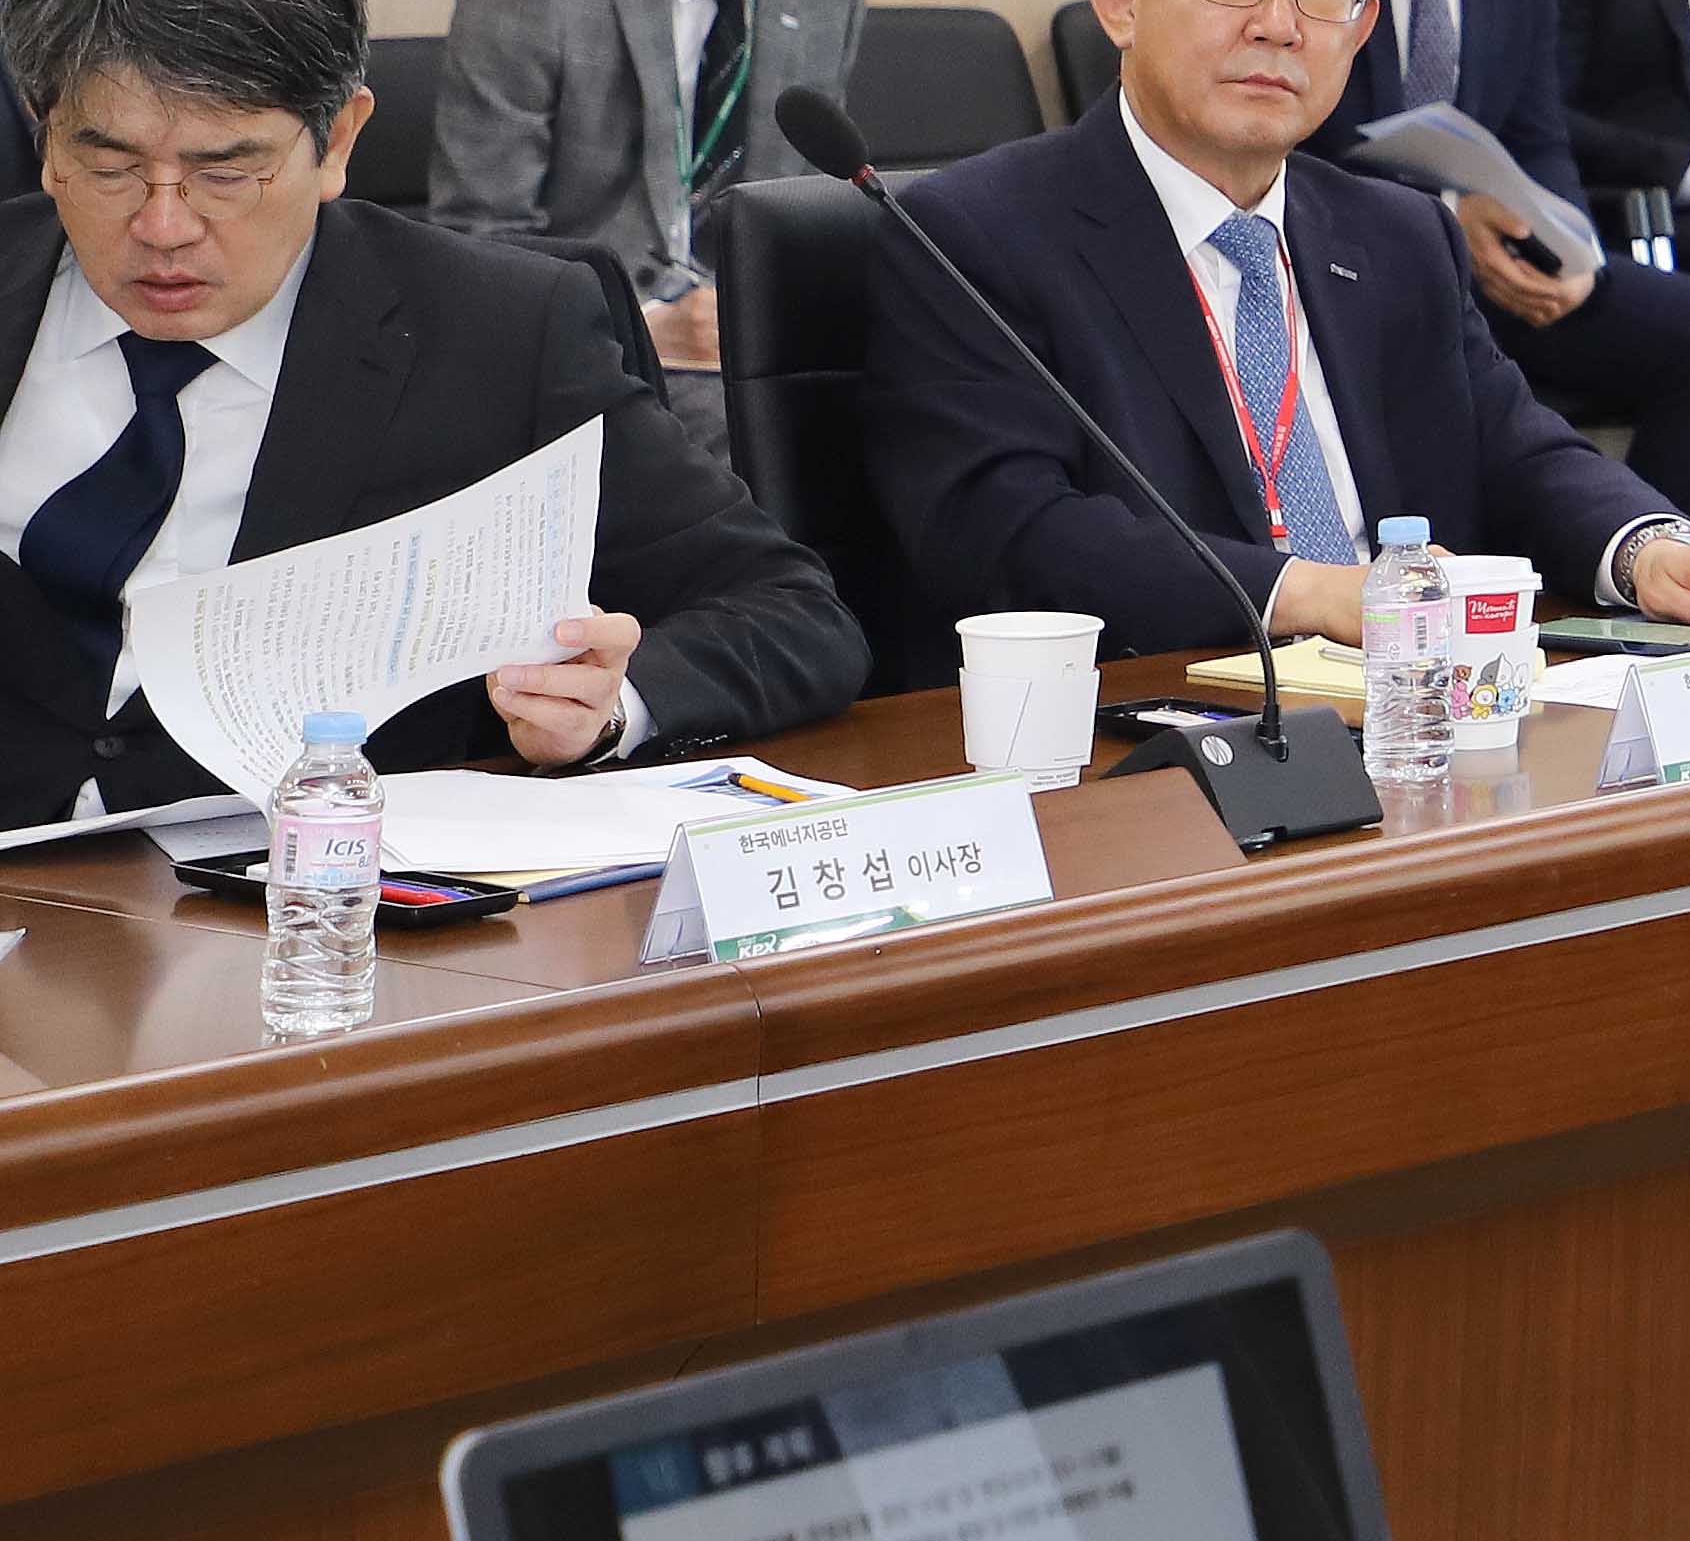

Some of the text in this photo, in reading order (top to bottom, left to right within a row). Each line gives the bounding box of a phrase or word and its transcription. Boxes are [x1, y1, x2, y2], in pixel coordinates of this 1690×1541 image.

[325, 838, 367, 856] ICIS
[737, 817, 849, 855] 한국에너지공단
[766, 841, 983, 911] 김창섭 이사장
